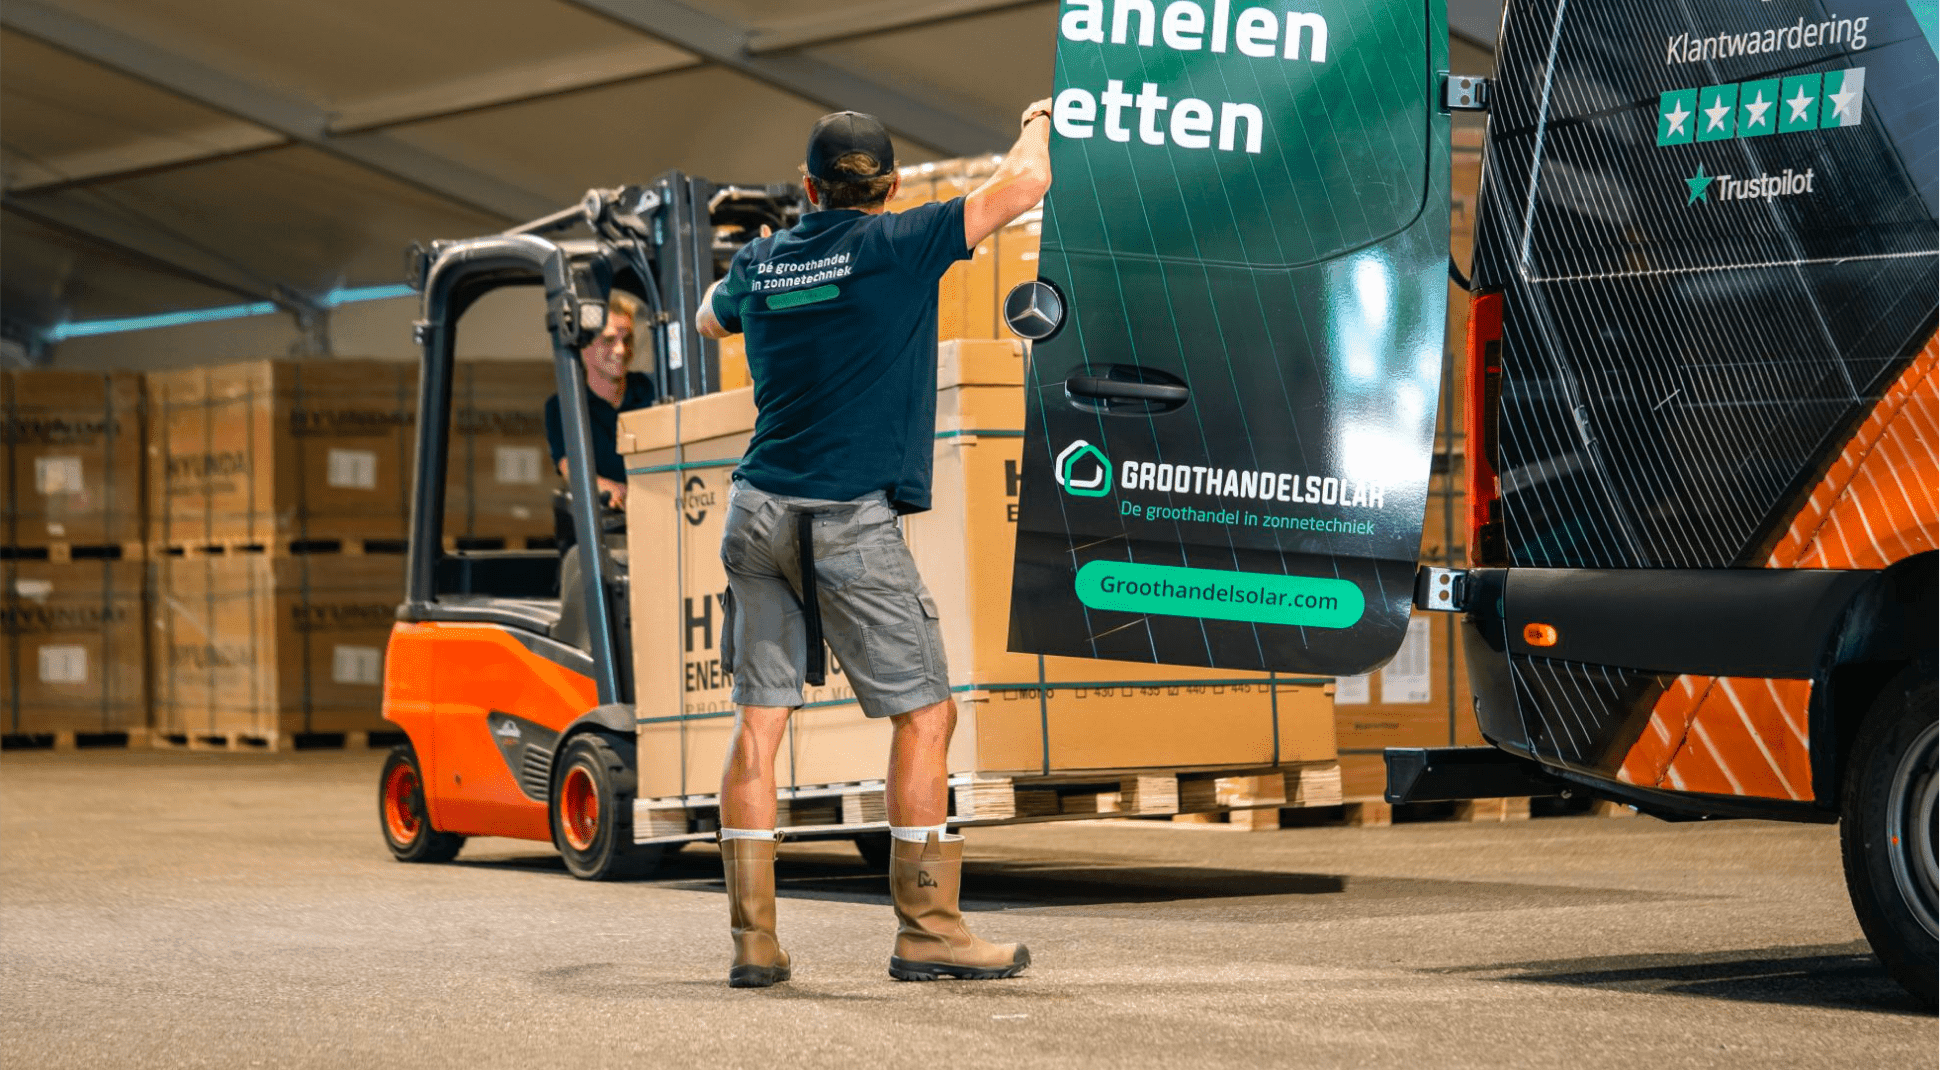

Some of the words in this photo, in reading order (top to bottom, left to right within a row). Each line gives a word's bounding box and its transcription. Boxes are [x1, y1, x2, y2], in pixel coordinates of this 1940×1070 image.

[1061, 0, 1328, 63] anelen
[1666, 14, 1869, 65] Klantwaardering
[1053, 79, 1263, 154] etten
[1716, 168, 1814, 203] Trustpilot
[752, 280, 762, 291] in
[764, 265, 852, 289] zonnetechniek
[776, 252, 850, 275] groothandel
[1121, 460, 1384, 509] GROOTHANDELSOLAR
[1121, 500, 1141, 517] De
[1146, 506, 1240, 525] groothandel
[1244, 511, 1258, 526] in
[1262, 515, 1375, 535] zonnetechniek
[1100, 576, 1338, 610] Groothandelsolar.com
